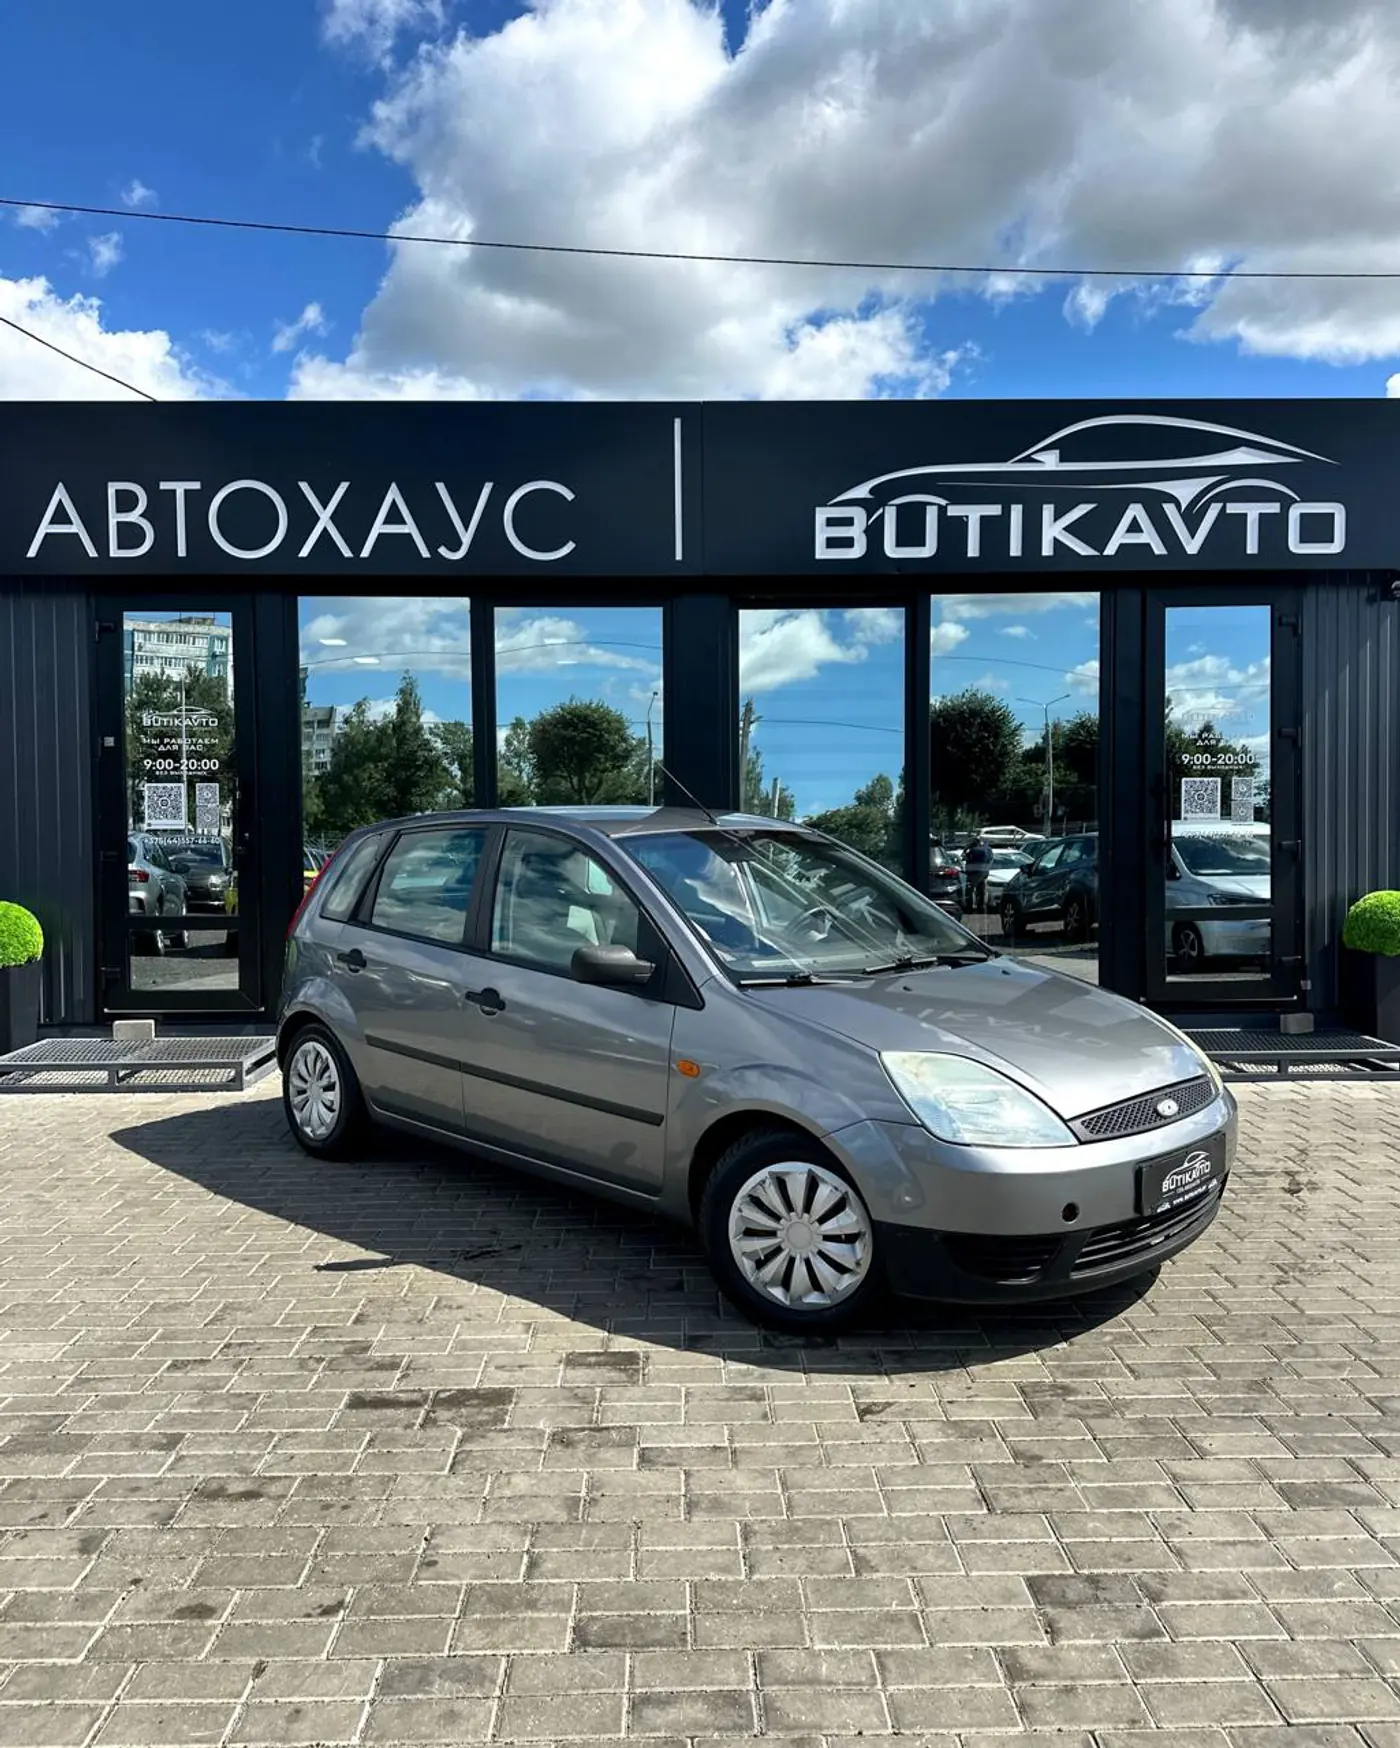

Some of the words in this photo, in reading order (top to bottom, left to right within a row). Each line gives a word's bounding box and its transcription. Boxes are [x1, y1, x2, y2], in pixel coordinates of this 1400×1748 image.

[26, 479, 577, 560] АВТОХАУС
[814, 501, 1347, 559] BUTIKAVTO
[143, 759, 219, 770] 9:00-20:00
[1181, 753, 1255, 765] 9:00-20:00
[1162, 1161, 1211, 1192] BUTIKAVTO
